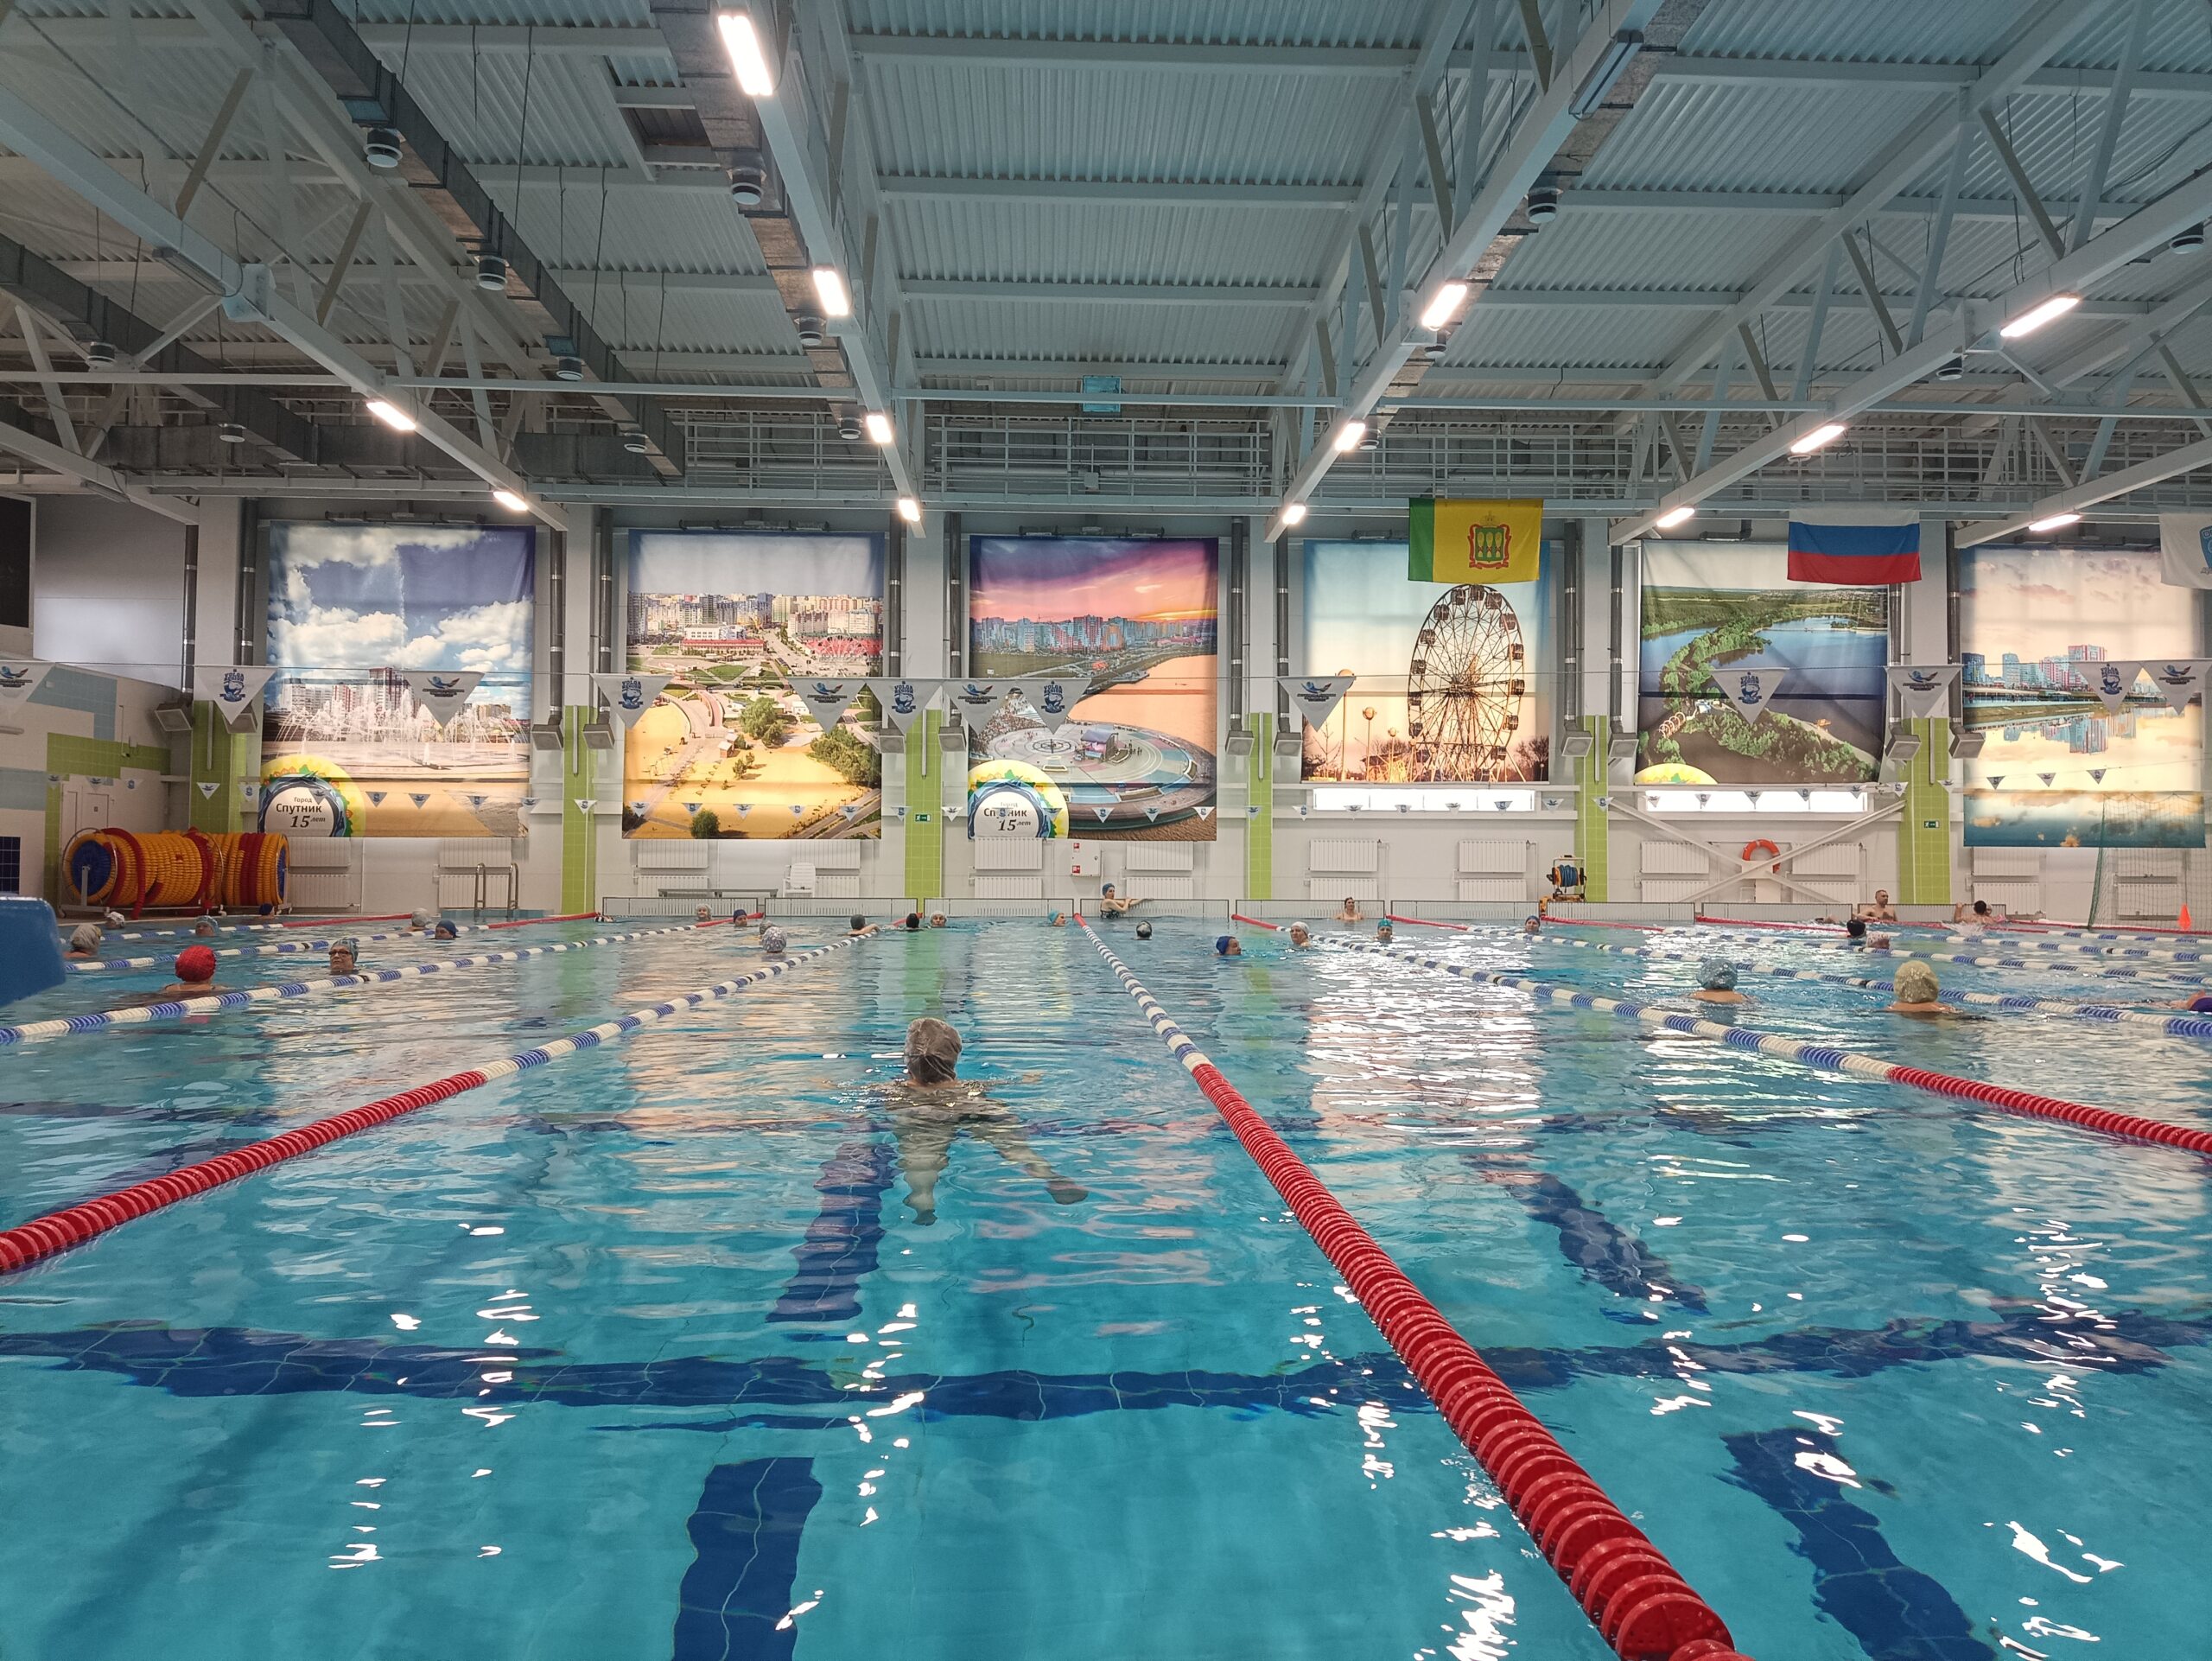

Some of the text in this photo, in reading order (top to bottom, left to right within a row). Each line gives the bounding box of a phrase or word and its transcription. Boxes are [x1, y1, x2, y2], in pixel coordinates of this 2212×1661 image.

[276, 803, 322, 815] Спутник
[983, 807, 1027, 819] Спник
[290, 815, 310, 828] 15
[998, 818, 1017, 831] 15
